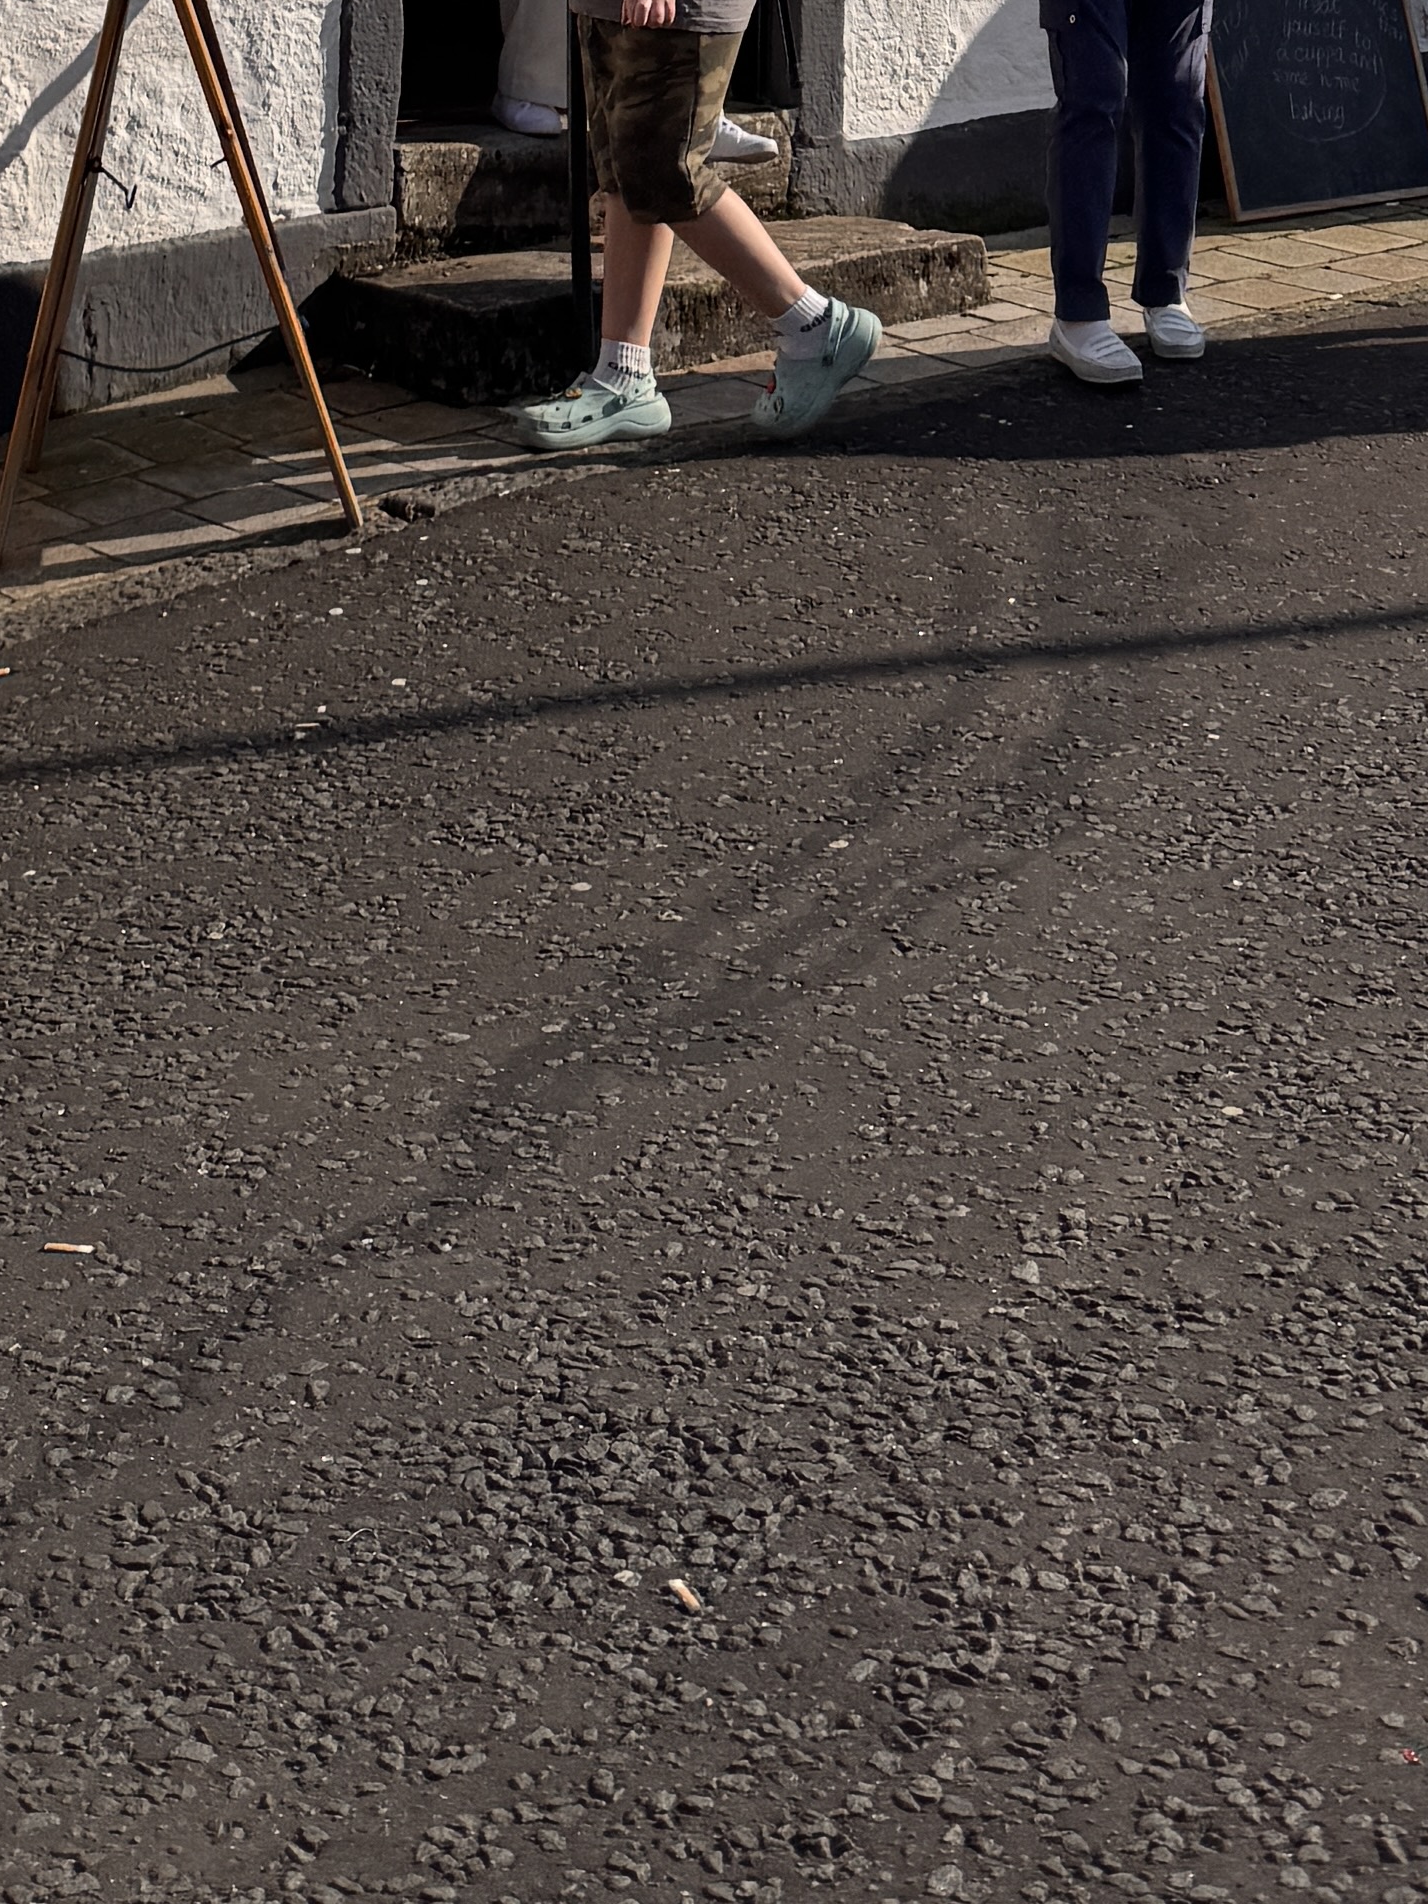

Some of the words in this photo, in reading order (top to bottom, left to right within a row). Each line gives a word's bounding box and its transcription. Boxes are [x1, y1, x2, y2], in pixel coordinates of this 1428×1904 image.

[1355, 28, 1371, 50] to
[1294, 45, 1345, 68] cuppa
[1289, 92, 1345, 129] baking
